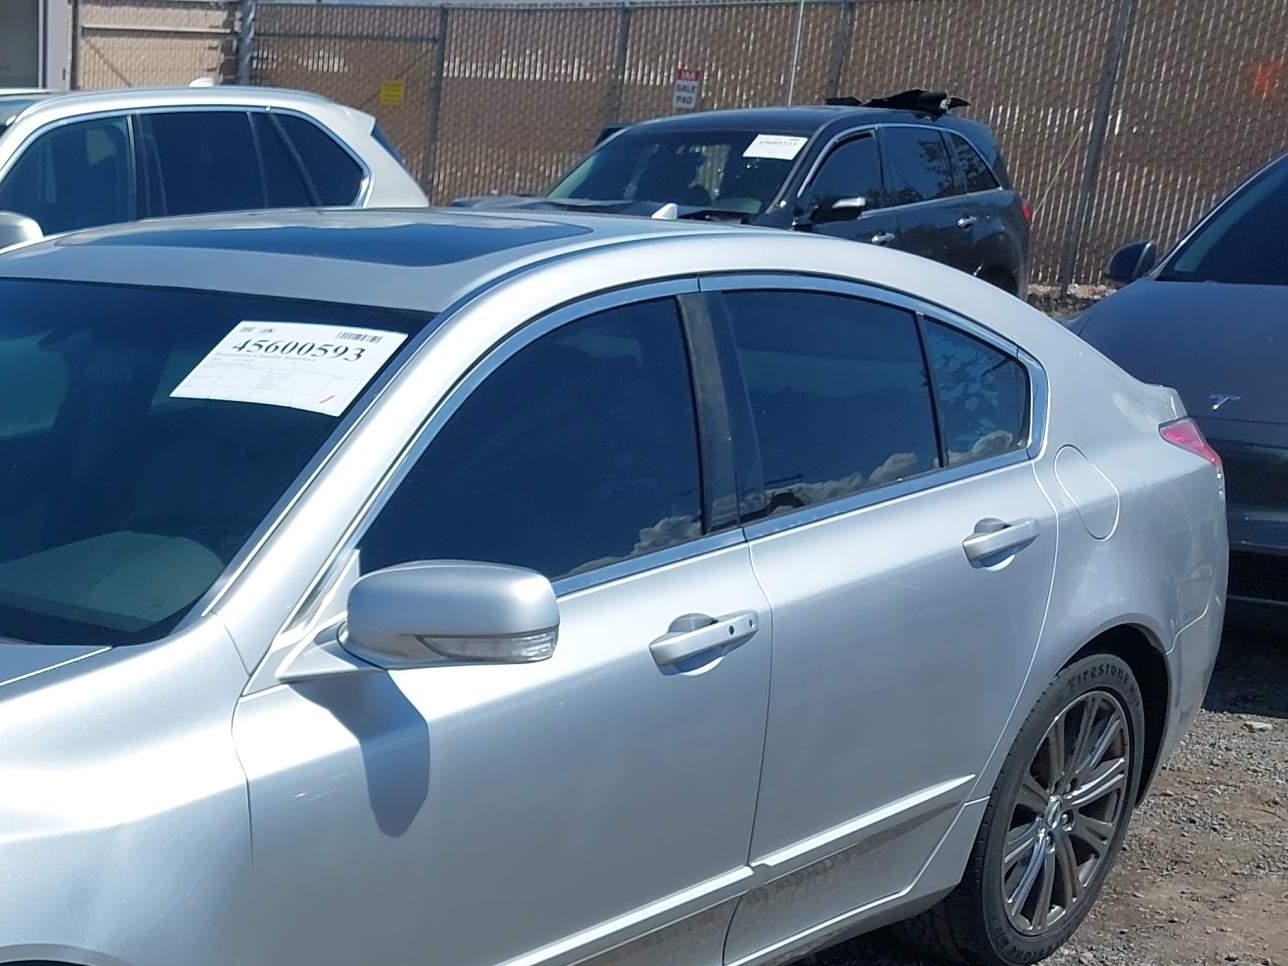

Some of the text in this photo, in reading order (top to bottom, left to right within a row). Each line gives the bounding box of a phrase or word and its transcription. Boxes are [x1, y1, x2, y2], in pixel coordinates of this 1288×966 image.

[676, 84, 696, 93] SALE
[675, 95, 693, 104] PAD
[232, 339, 366, 362] 45600593
[1068, 663, 1130, 691] Firestone
